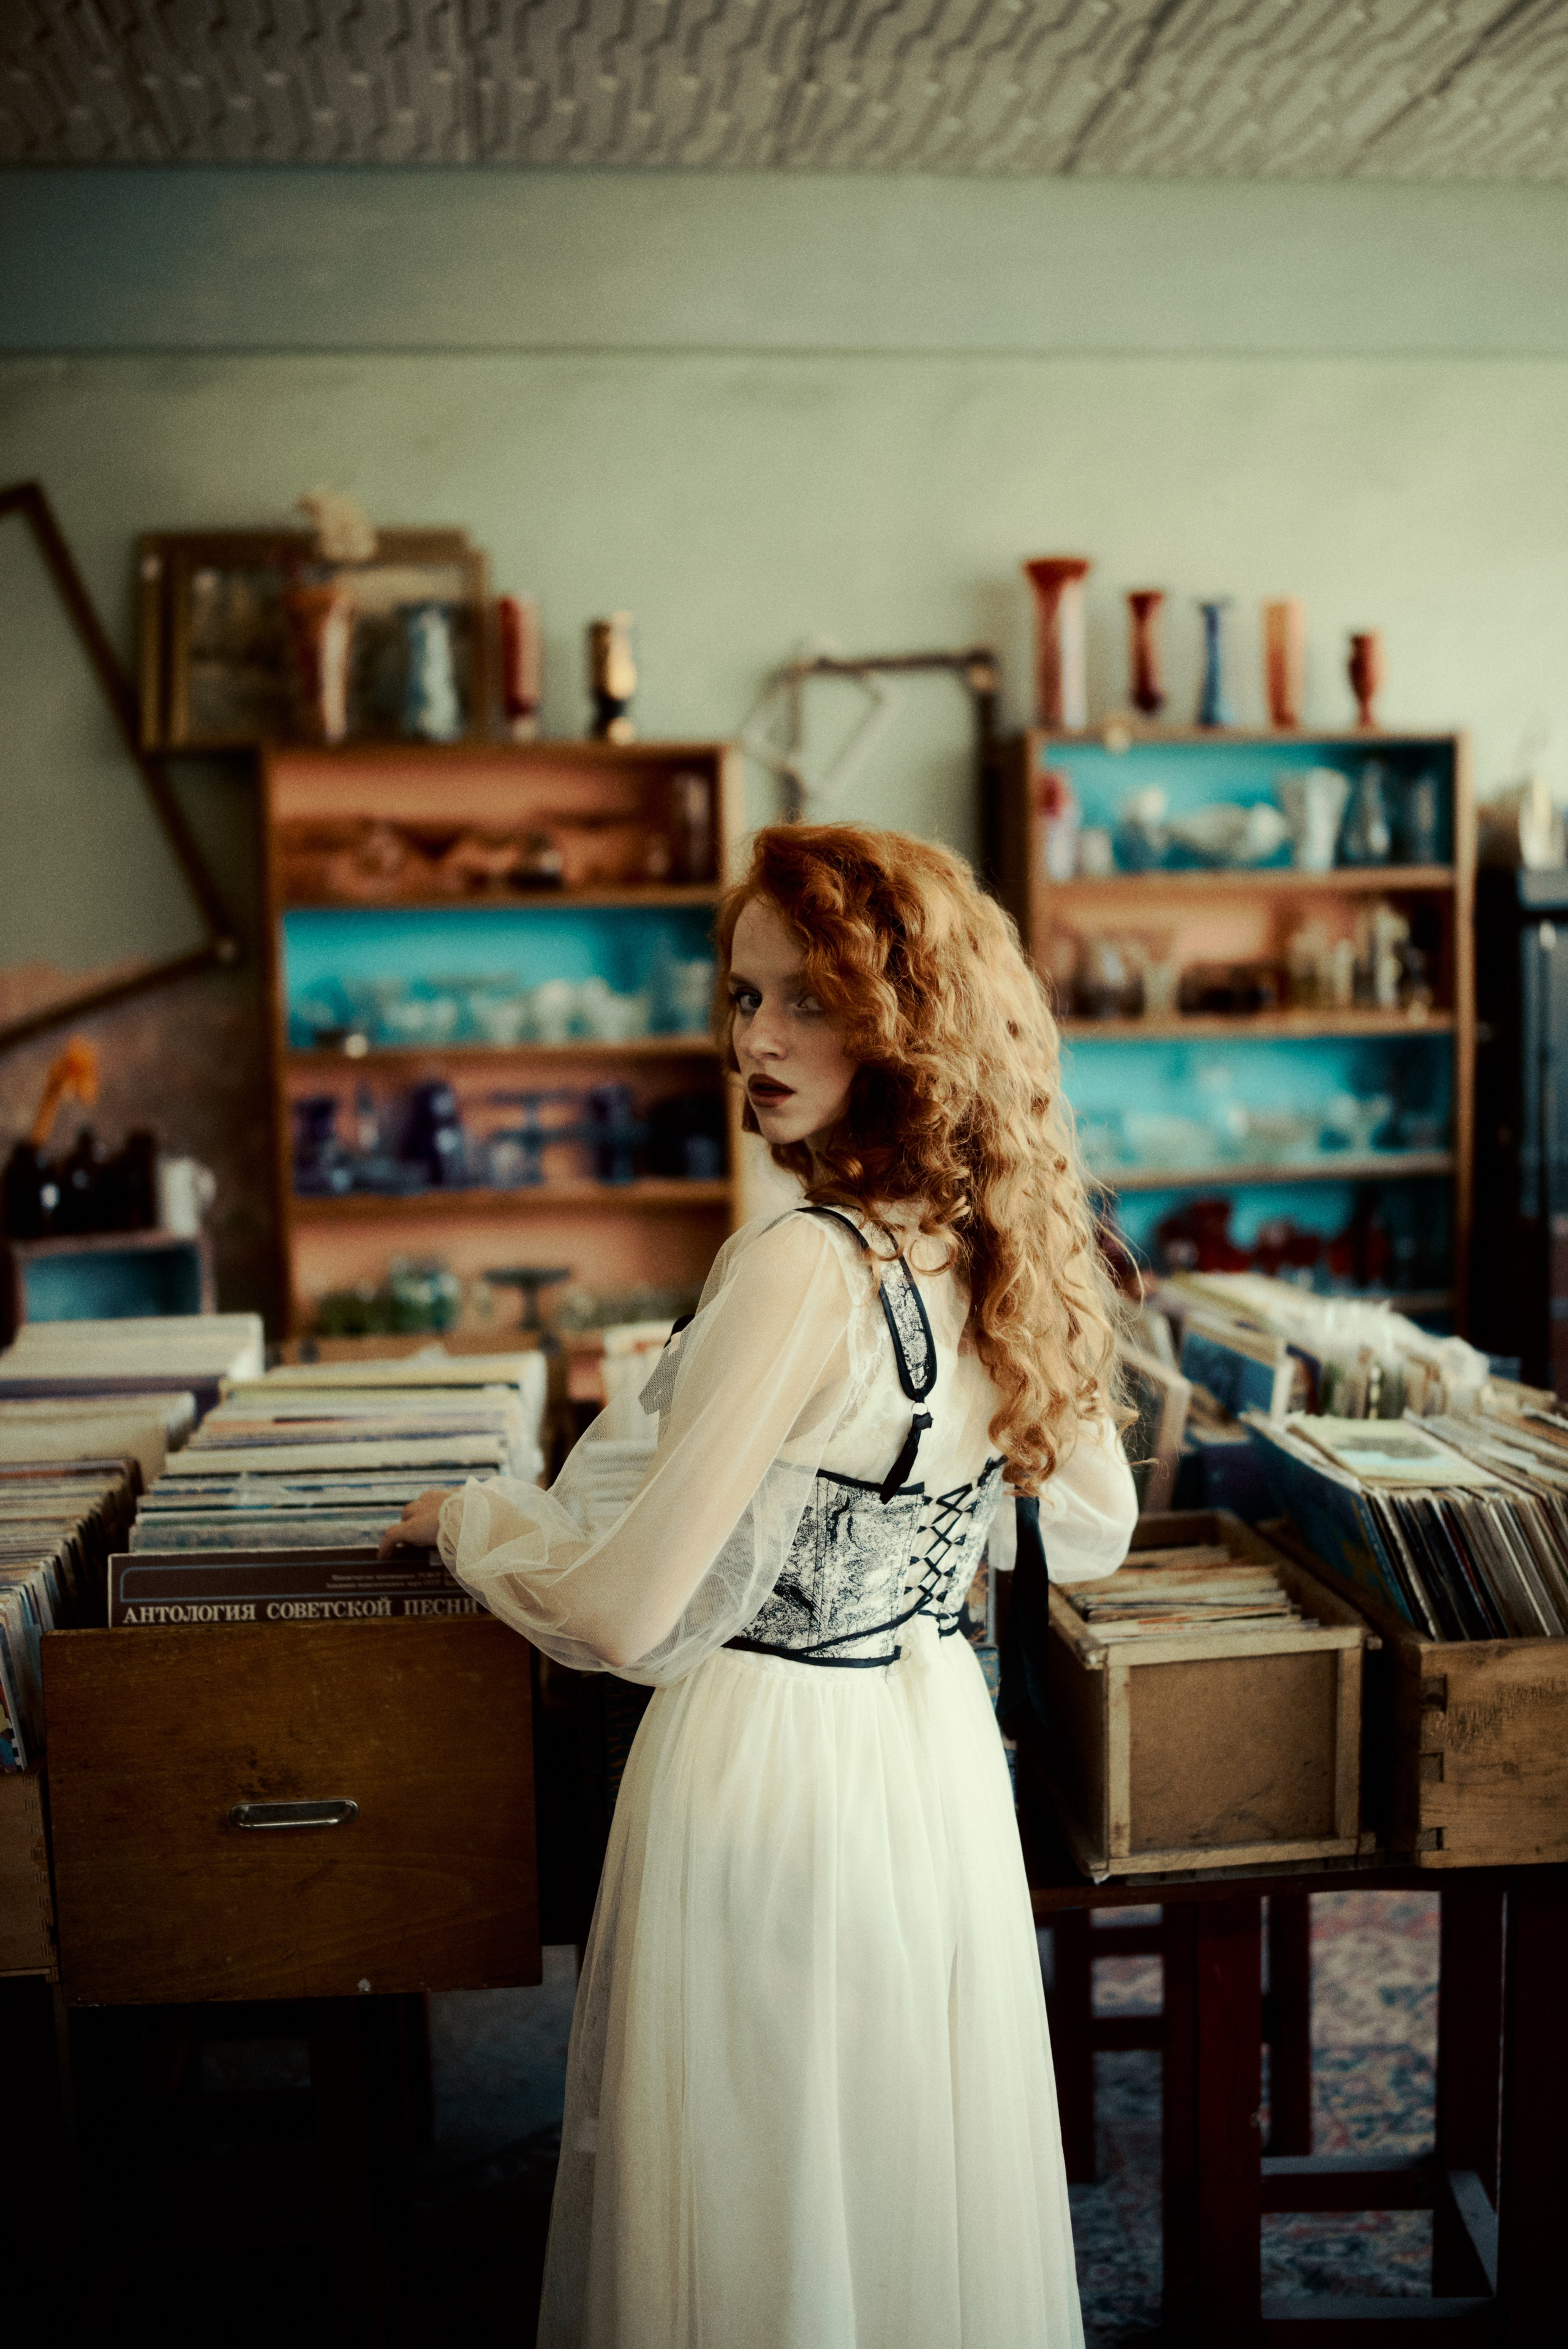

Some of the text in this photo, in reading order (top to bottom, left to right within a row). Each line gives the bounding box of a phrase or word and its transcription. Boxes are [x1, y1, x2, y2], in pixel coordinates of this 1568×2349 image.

[122, 1596, 478, 1624] АНТОЛОГИЯ СОВЕТСКОЙ ПЕСНИ
